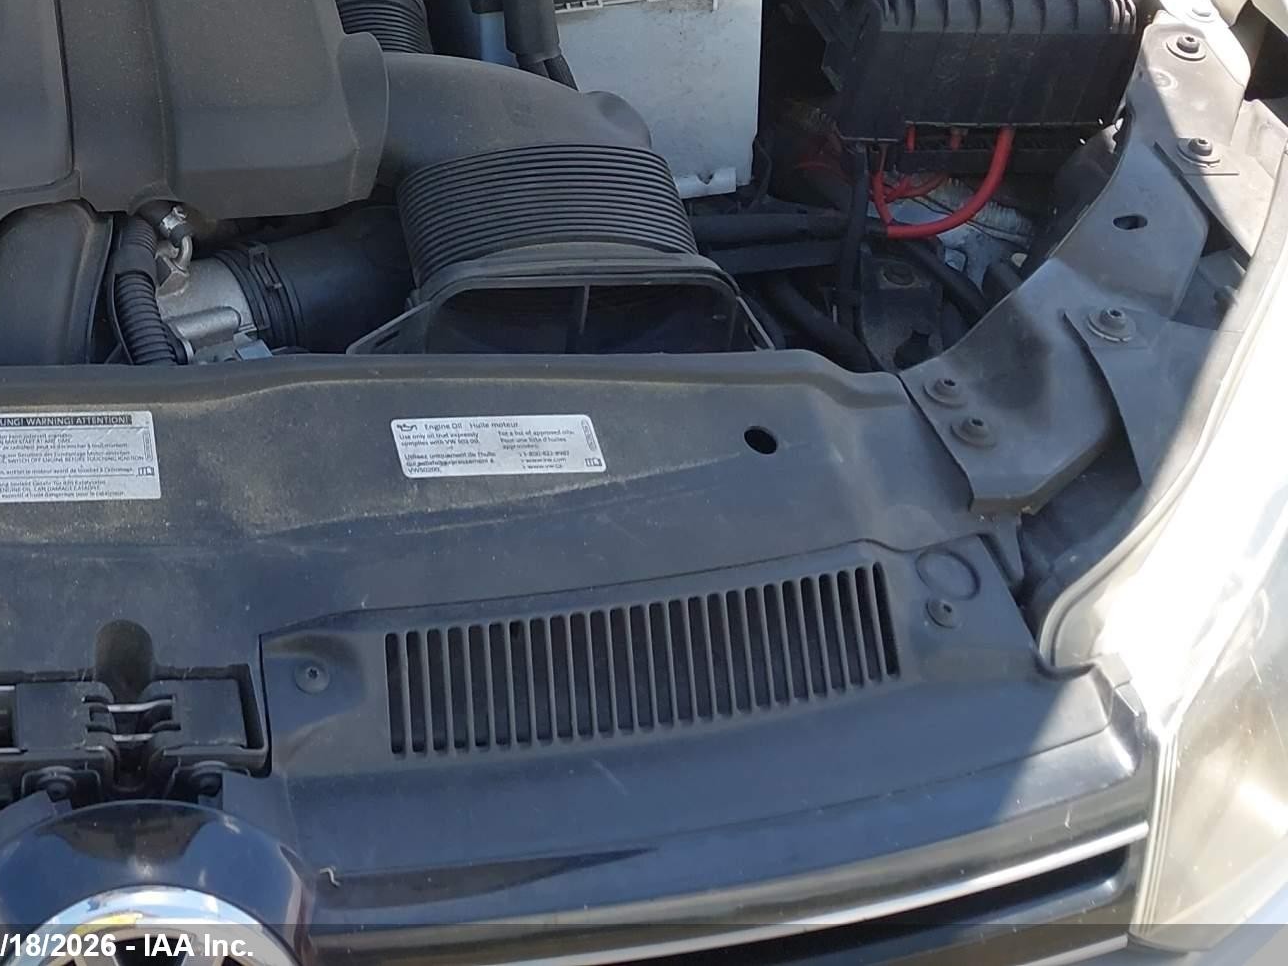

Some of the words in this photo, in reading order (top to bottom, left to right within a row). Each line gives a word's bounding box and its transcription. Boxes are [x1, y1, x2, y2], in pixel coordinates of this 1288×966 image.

[27, 417, 74, 426] WARNING!
[76, 416, 130, 425] ATTENTION!
[425, 423, 451, 431] Engine
